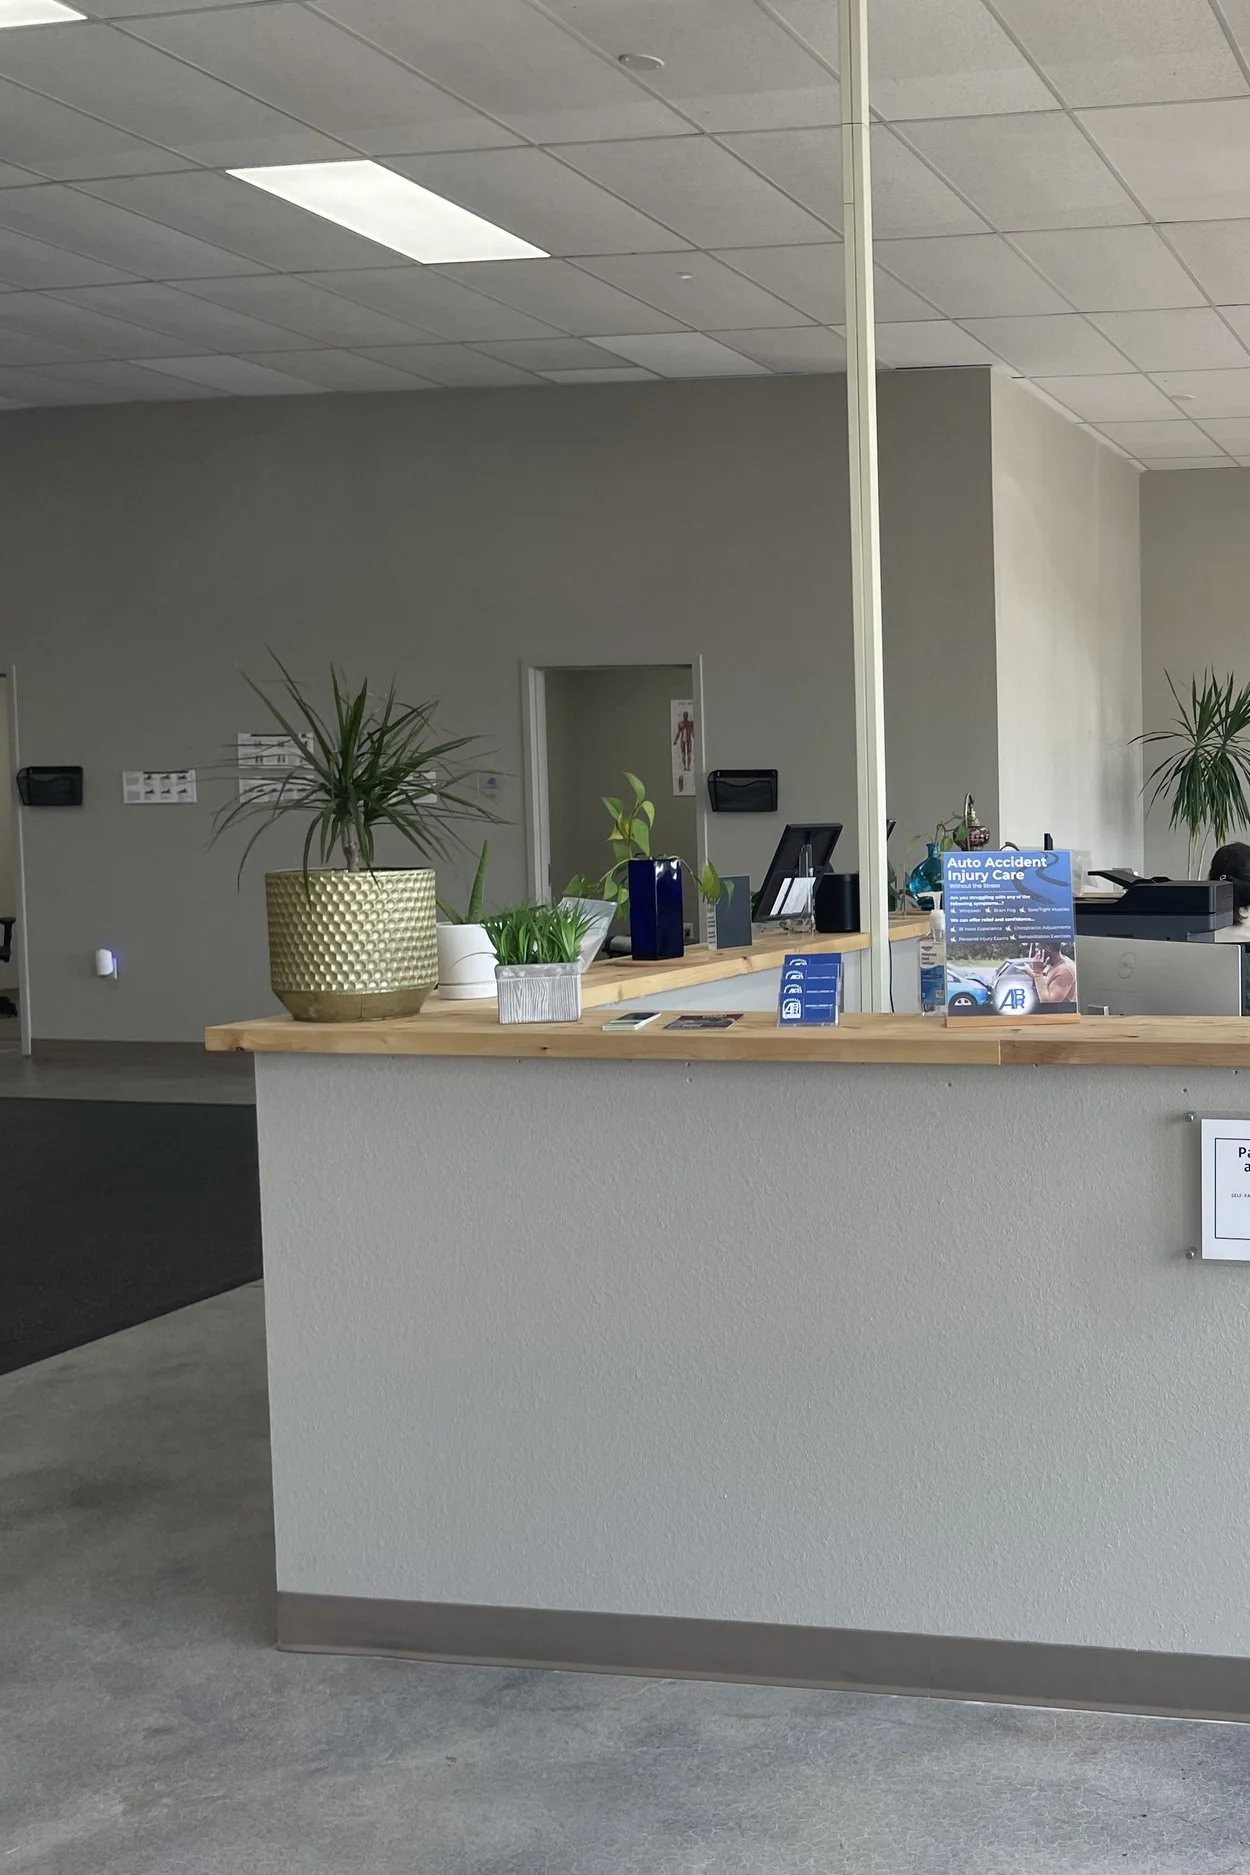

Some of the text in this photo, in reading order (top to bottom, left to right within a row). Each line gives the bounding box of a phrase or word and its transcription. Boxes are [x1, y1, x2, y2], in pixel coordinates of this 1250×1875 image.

[947, 856, 1047, 868] Auto Accident
[948, 870, 1024, 882] Injury Care
